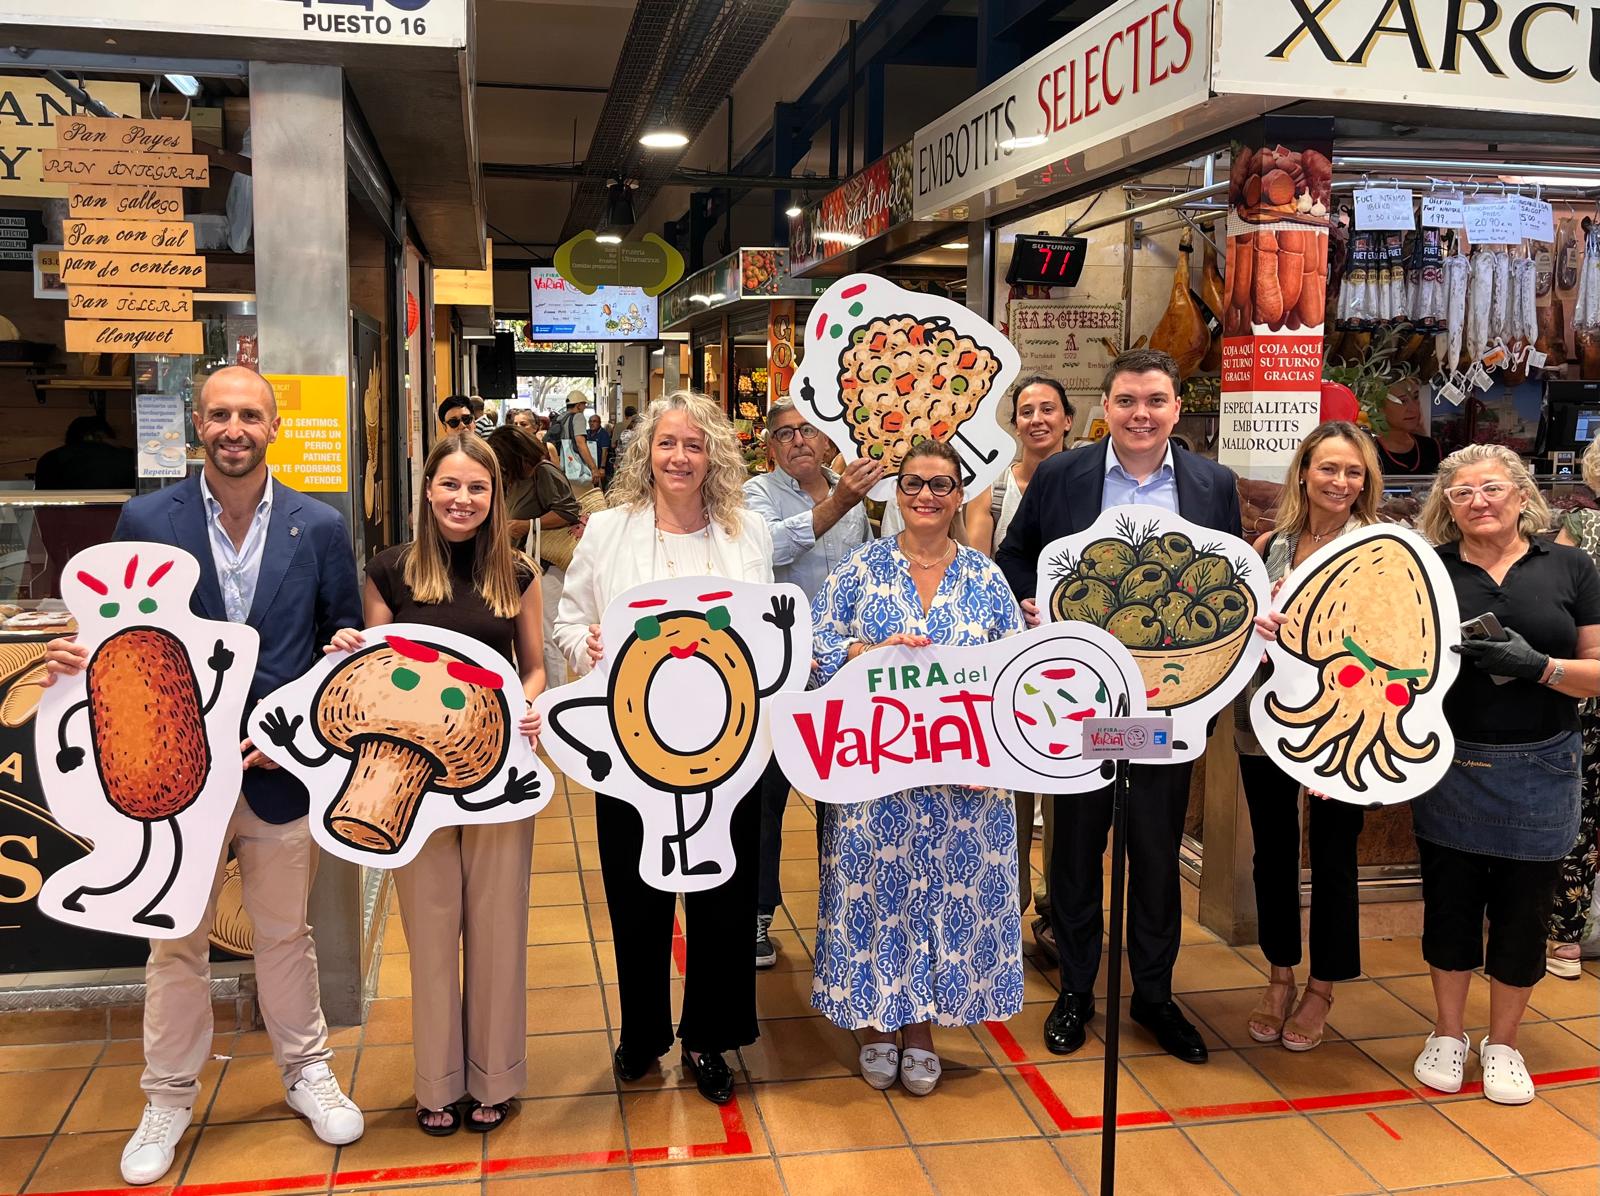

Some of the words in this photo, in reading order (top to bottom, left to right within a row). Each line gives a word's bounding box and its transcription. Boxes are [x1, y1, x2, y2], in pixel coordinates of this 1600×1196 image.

[303, 13, 392, 35] PUESTO
[400, 17, 427, 36] 16
[1265, 0, 1600, 84] XARC
[919, 95, 1017, 197] EMBOTITS
[1037, 0, 1193, 137] SELECTES
[63, 121, 107, 143] Pan
[121, 125, 181, 151] Payes
[45, 159, 97, 174] PAN
[68, 222, 110, 246] Pan
[116, 229, 148, 241] con
[1046, 244, 1076, 252] TURNO
[1424, 246, 1438, 255] FUET
[1039, 247, 1071, 276] 71
[1353, 251, 1367, 260] FUET
[62, 257, 97, 279] pan
[97, 260, 119, 279] de
[130, 259, 203, 277] centeno
[71, 294, 109, 309] Pan
[116, 298, 189, 313] TELERA
[96, 326, 174, 349] llonguet
[1223, 345, 1238, 357] COJA
[1239, 341, 1254, 356] AQUÍ
[1259, 343, 1288, 356] COJA
[1291, 340, 1321, 356] AQUÍ
[1223, 359, 1232, 369] SU
[1232, 358, 1253, 369] TURNO
[1259, 357, 1275, 368] SU
[1278, 357, 1320, 368] TURNO
[1225, 371, 1251, 382] GRACIAS
[1264, 371, 1315, 381] GRACIAS
[1223, 401, 1318, 414] ESPECIALITATS
[282, 418, 293, 427] LO
[1233, 419, 1299, 432] EMBUTITS
[284, 430, 293, 439] SI
[295, 430, 327, 439] LLEVAS
[329, 430, 342, 439] UN
[304, 441, 332, 450] PERRO
[335, 441, 342, 450] O
[303, 453, 342, 462] PATINETE
[283, 464, 292, 473] TE
[294, 464, 342, 474] PODREMOS
[304, 475, 342, 485] ATENDER
[867, 661, 949, 693] FIRA
[953, 666, 988, 685] del
